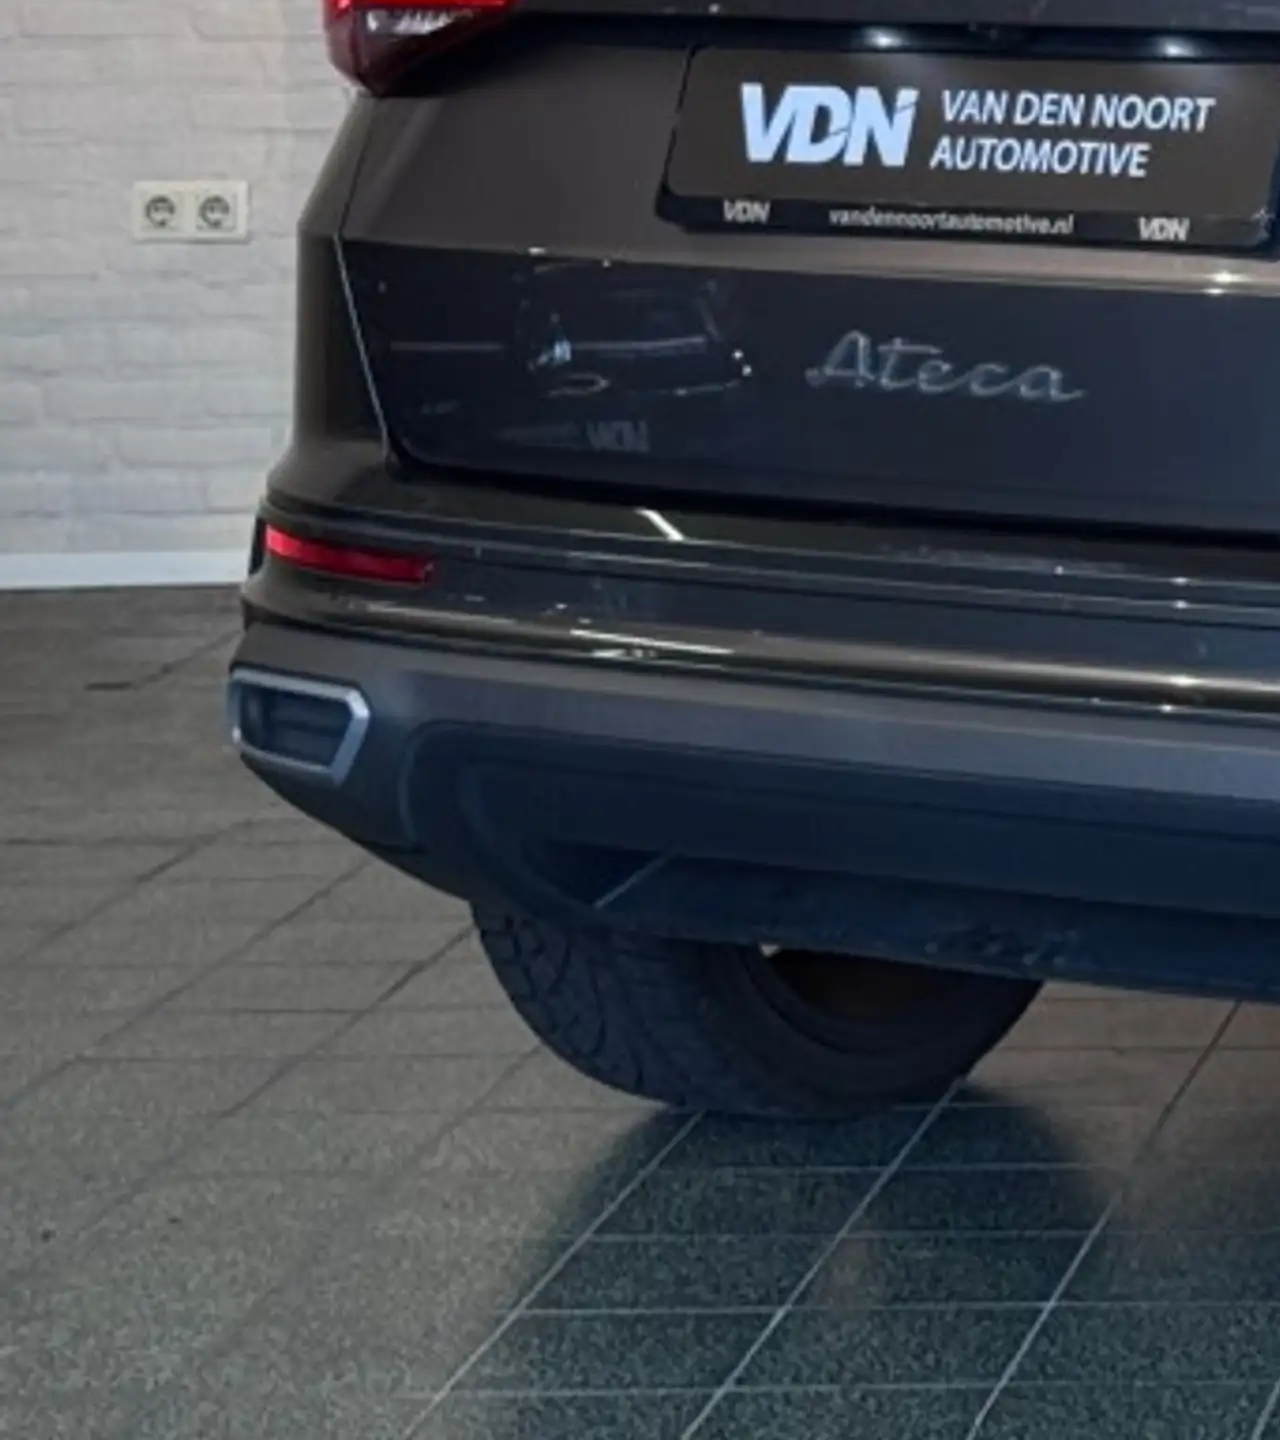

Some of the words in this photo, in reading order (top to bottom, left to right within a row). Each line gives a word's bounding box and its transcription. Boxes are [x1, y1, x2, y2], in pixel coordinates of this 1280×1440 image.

[741, 83, 918, 166] VDN
[942, 89, 1007, 123] VAN
[1014, 92, 1085, 127] DEN
[1090, 94, 1216, 131] NOORT
[930, 137, 1150, 177] AUTOMOTIVE
[723, 200, 770, 223] VDN
[828, 206, 1075, 234] vandennoortautomotive.nl
[1138, 217, 1190, 242] VDN
[804, 329, 1086, 402] Ateca
